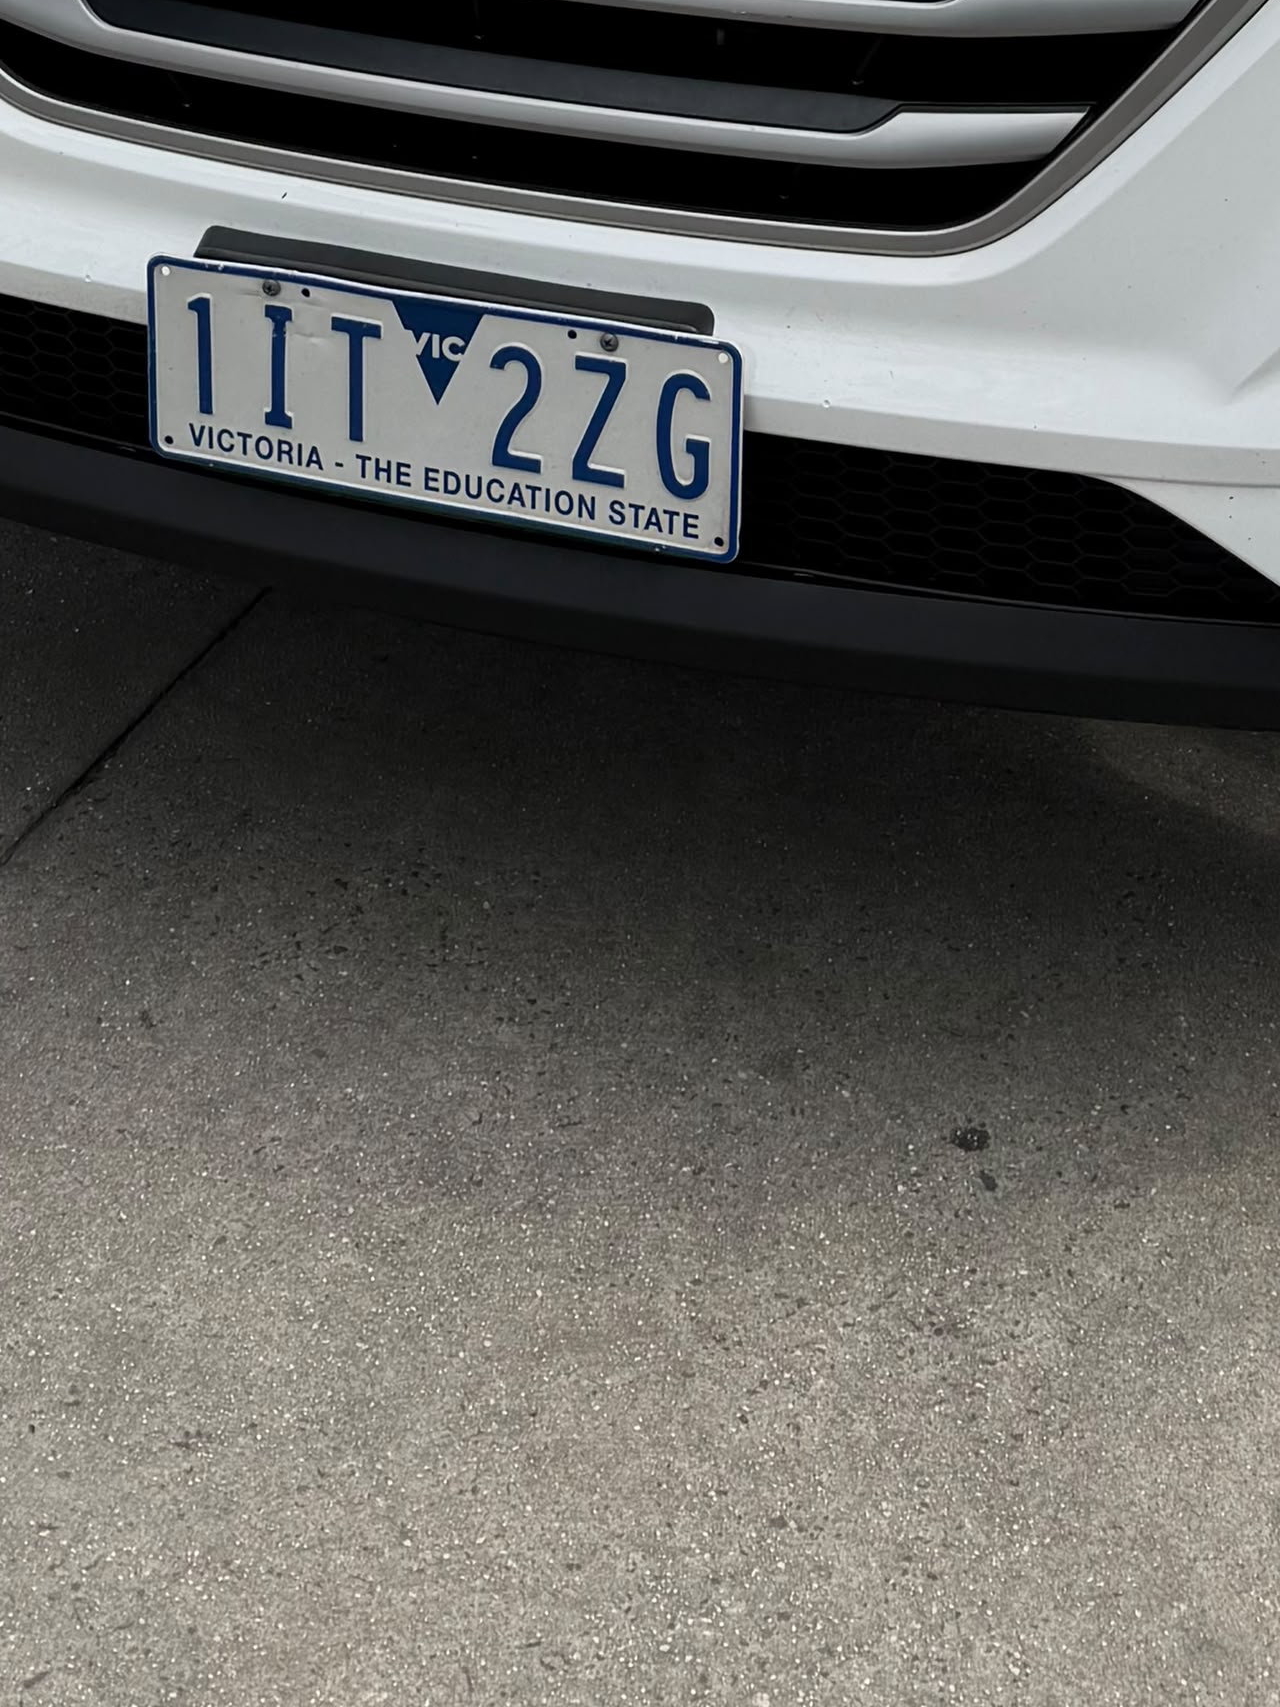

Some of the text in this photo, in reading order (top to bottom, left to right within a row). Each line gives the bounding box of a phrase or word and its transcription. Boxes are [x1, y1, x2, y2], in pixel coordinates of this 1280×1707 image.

[186, 294, 712, 501] 1IT VIC 2ZG
[189, 423, 325, 471] VICTORIA
[356, 454, 413, 488] THE
[424, 467, 597, 522] EDUCATION
[608, 501, 701, 540] STATE
